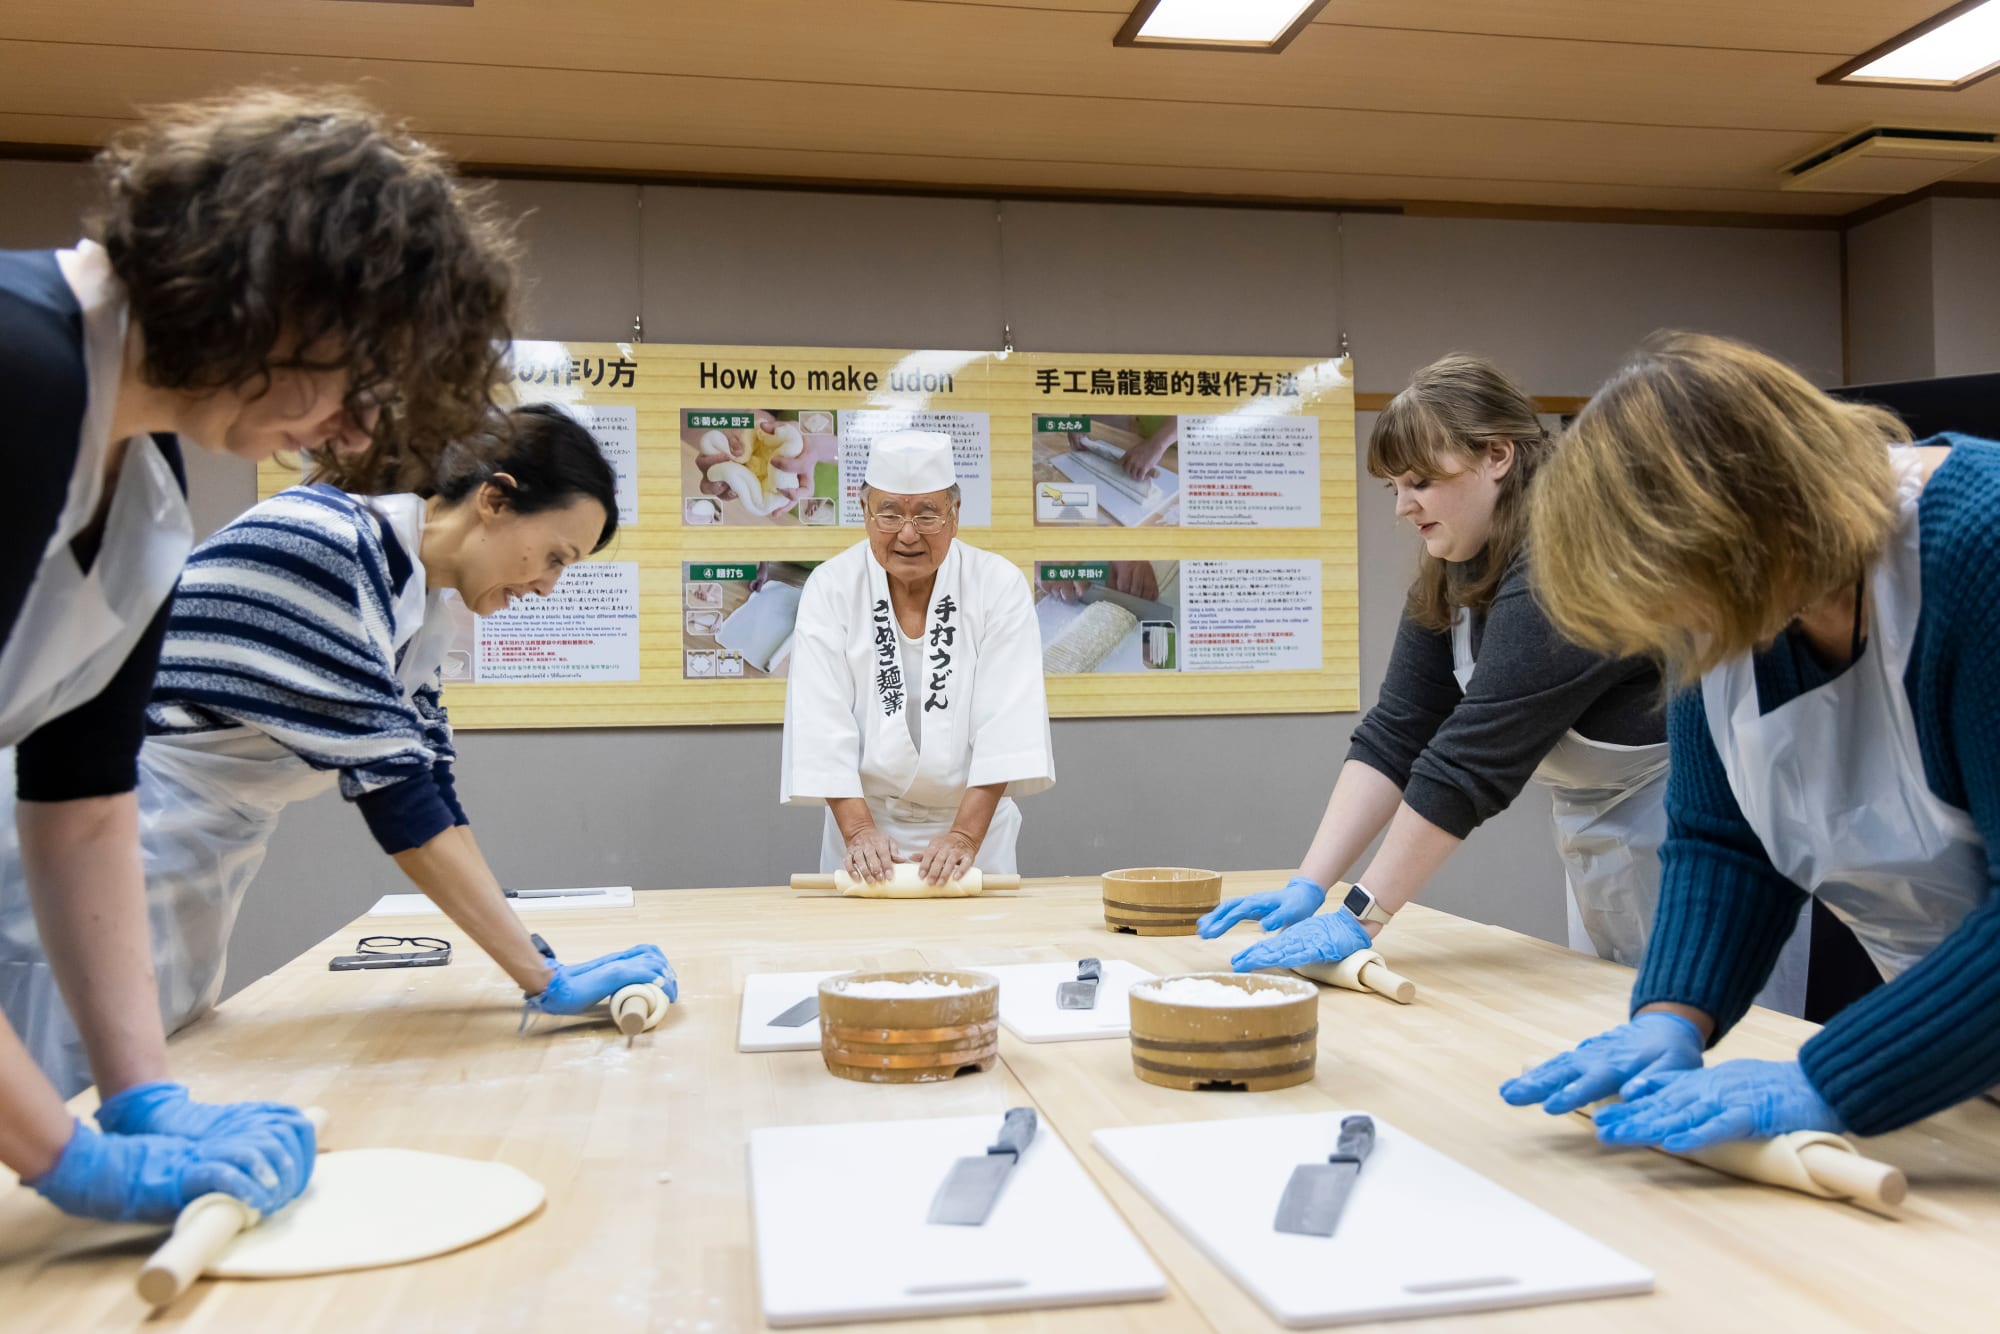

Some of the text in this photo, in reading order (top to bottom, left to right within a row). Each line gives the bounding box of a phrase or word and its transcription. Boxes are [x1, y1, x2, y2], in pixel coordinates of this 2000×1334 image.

[699, 362, 954, 393] How to make udon
[1058, 420, 1083, 430] たたみ
[924, 594, 957, 712] 手打うどん
